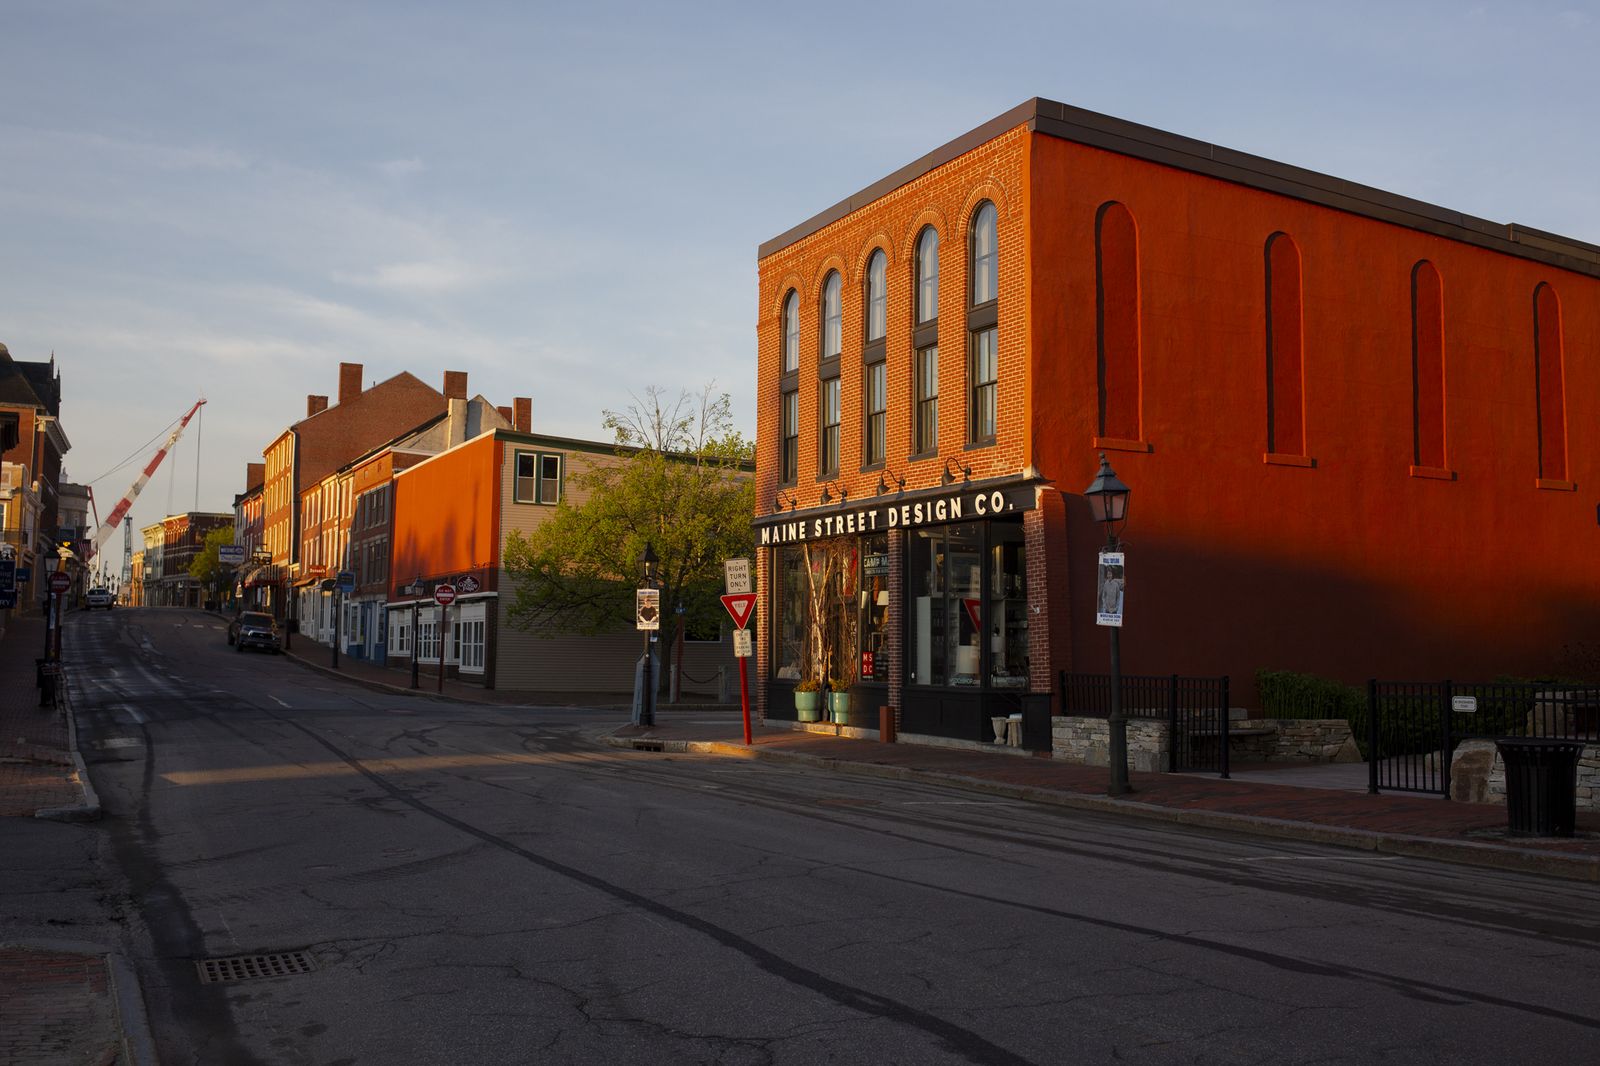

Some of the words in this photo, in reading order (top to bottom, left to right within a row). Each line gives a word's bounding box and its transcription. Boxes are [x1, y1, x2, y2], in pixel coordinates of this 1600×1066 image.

[761, 521, 806, 545] MAINE
[814, 510, 877, 537] STREET
[888, 497, 962, 527] DESIGN
[975, 491, 1013, 515] CO.
